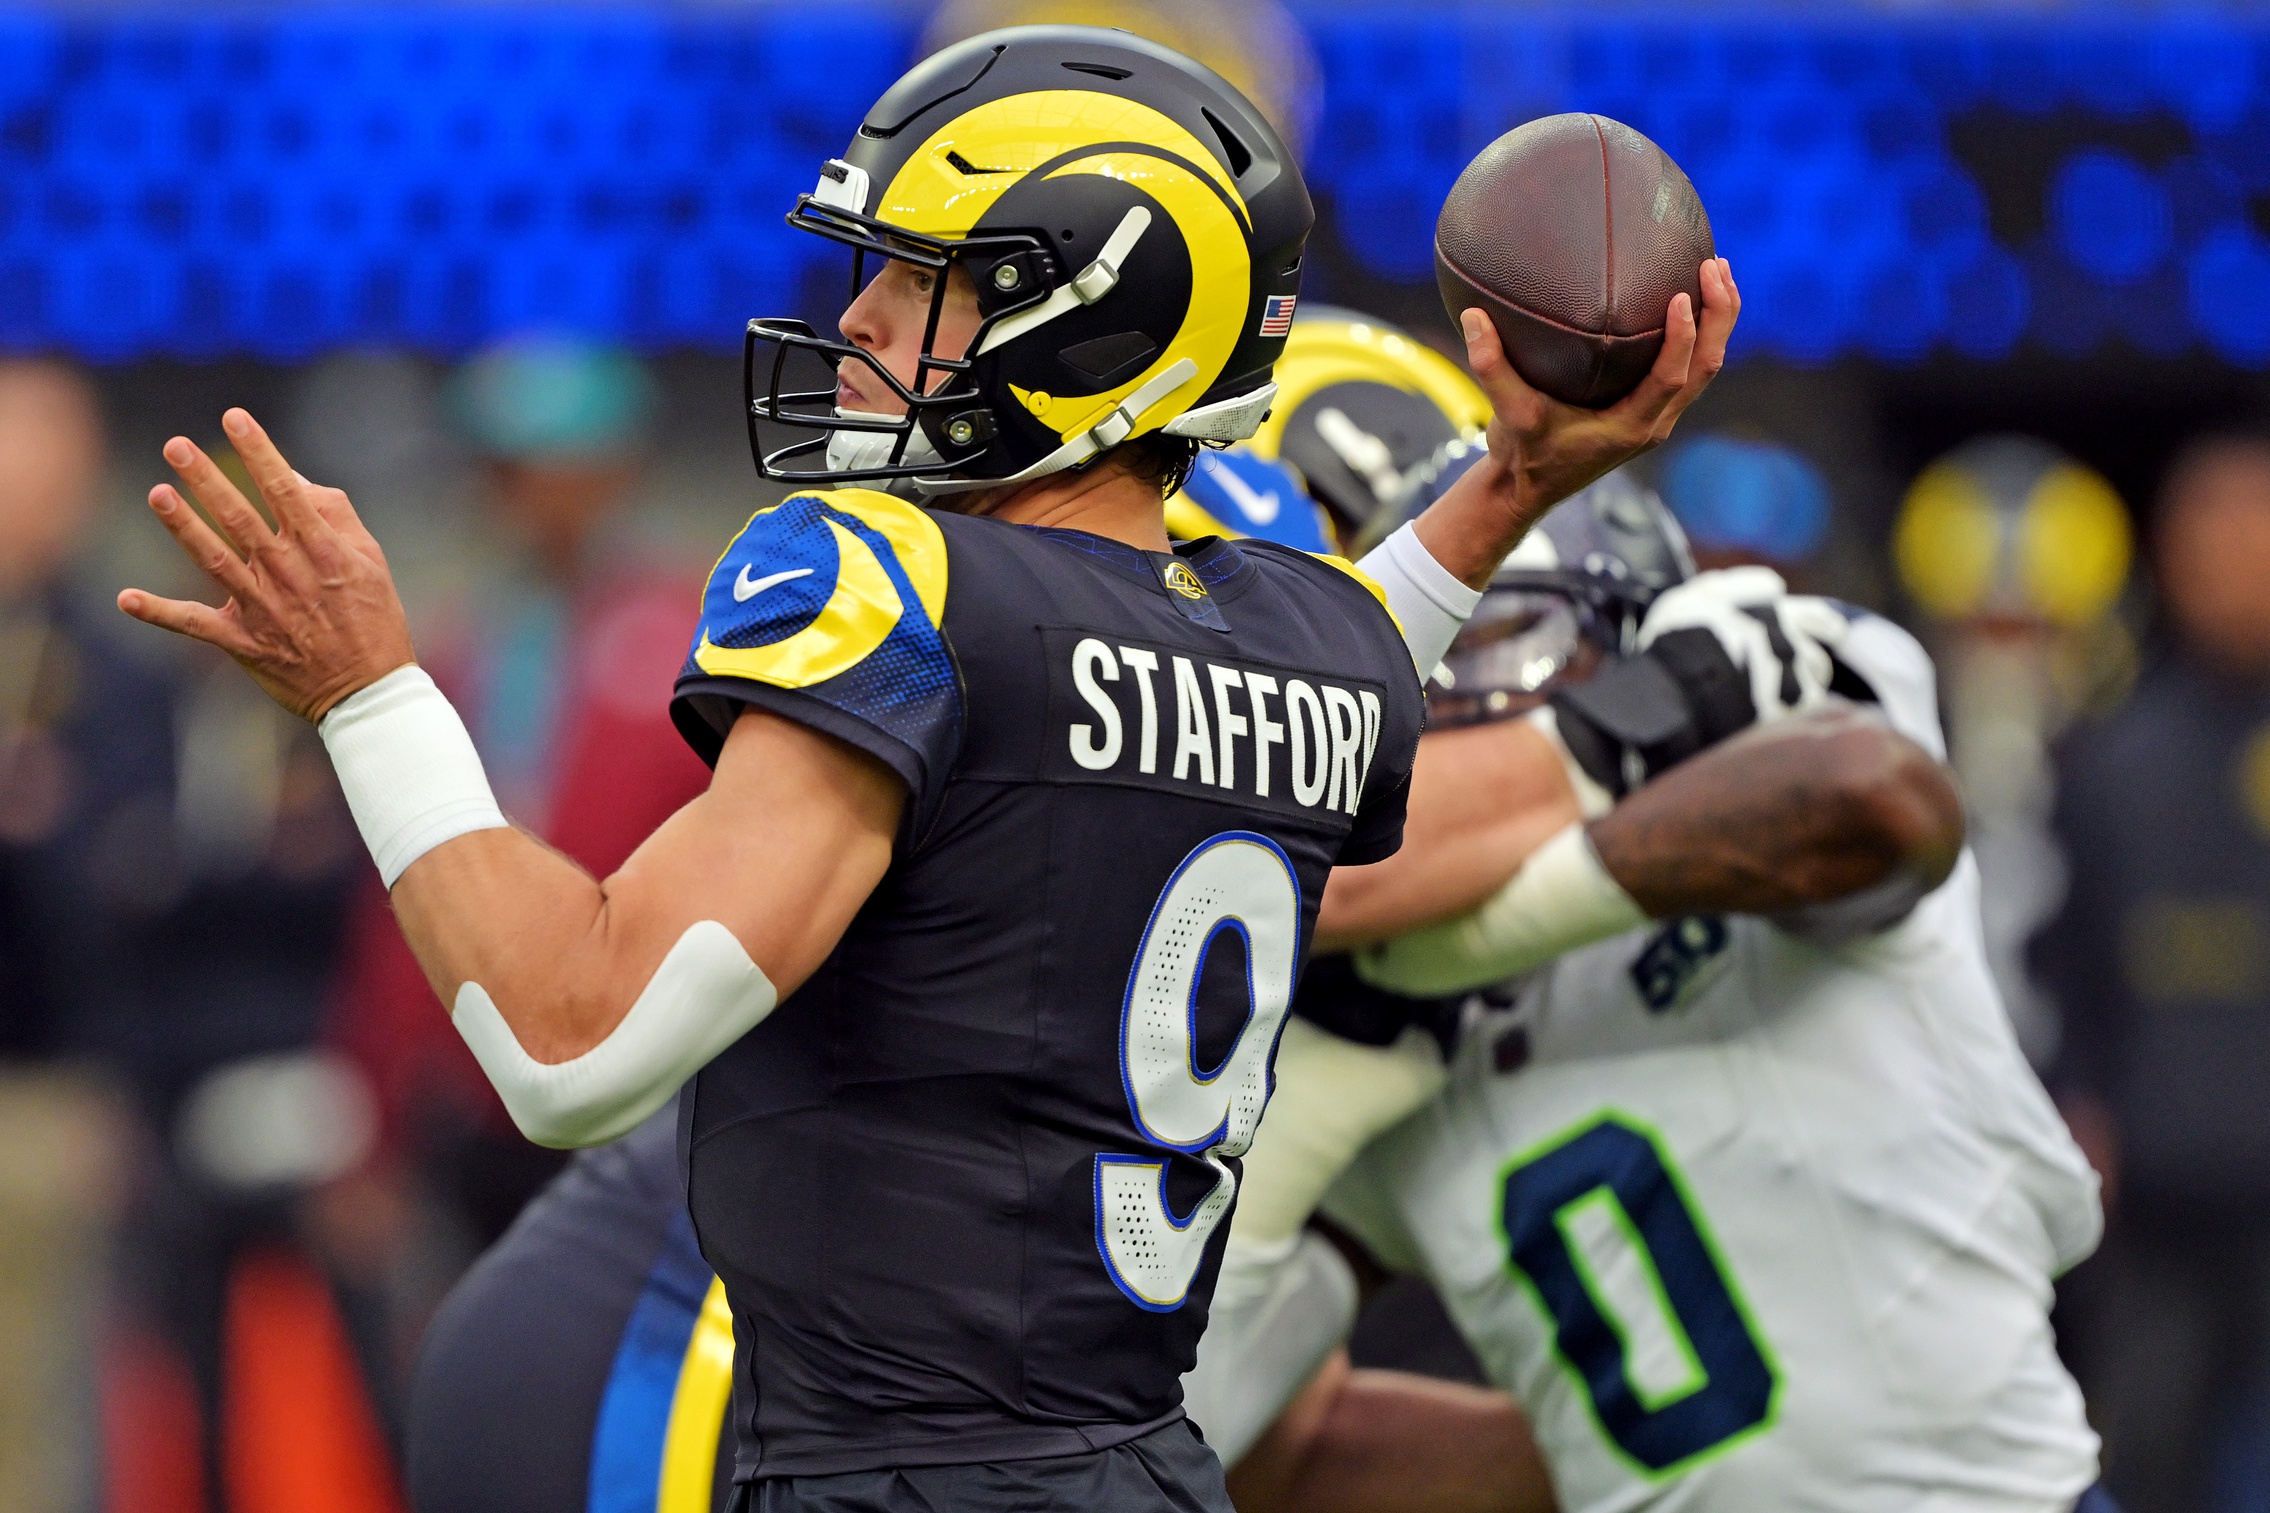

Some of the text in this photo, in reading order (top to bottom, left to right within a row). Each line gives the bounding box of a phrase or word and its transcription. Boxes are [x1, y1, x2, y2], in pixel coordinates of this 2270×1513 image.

[1069, 638, 1381, 816] STAFFORD
[1093, 830, 1301, 1313] 9
[1493, 1107, 1787, 1483] 0
